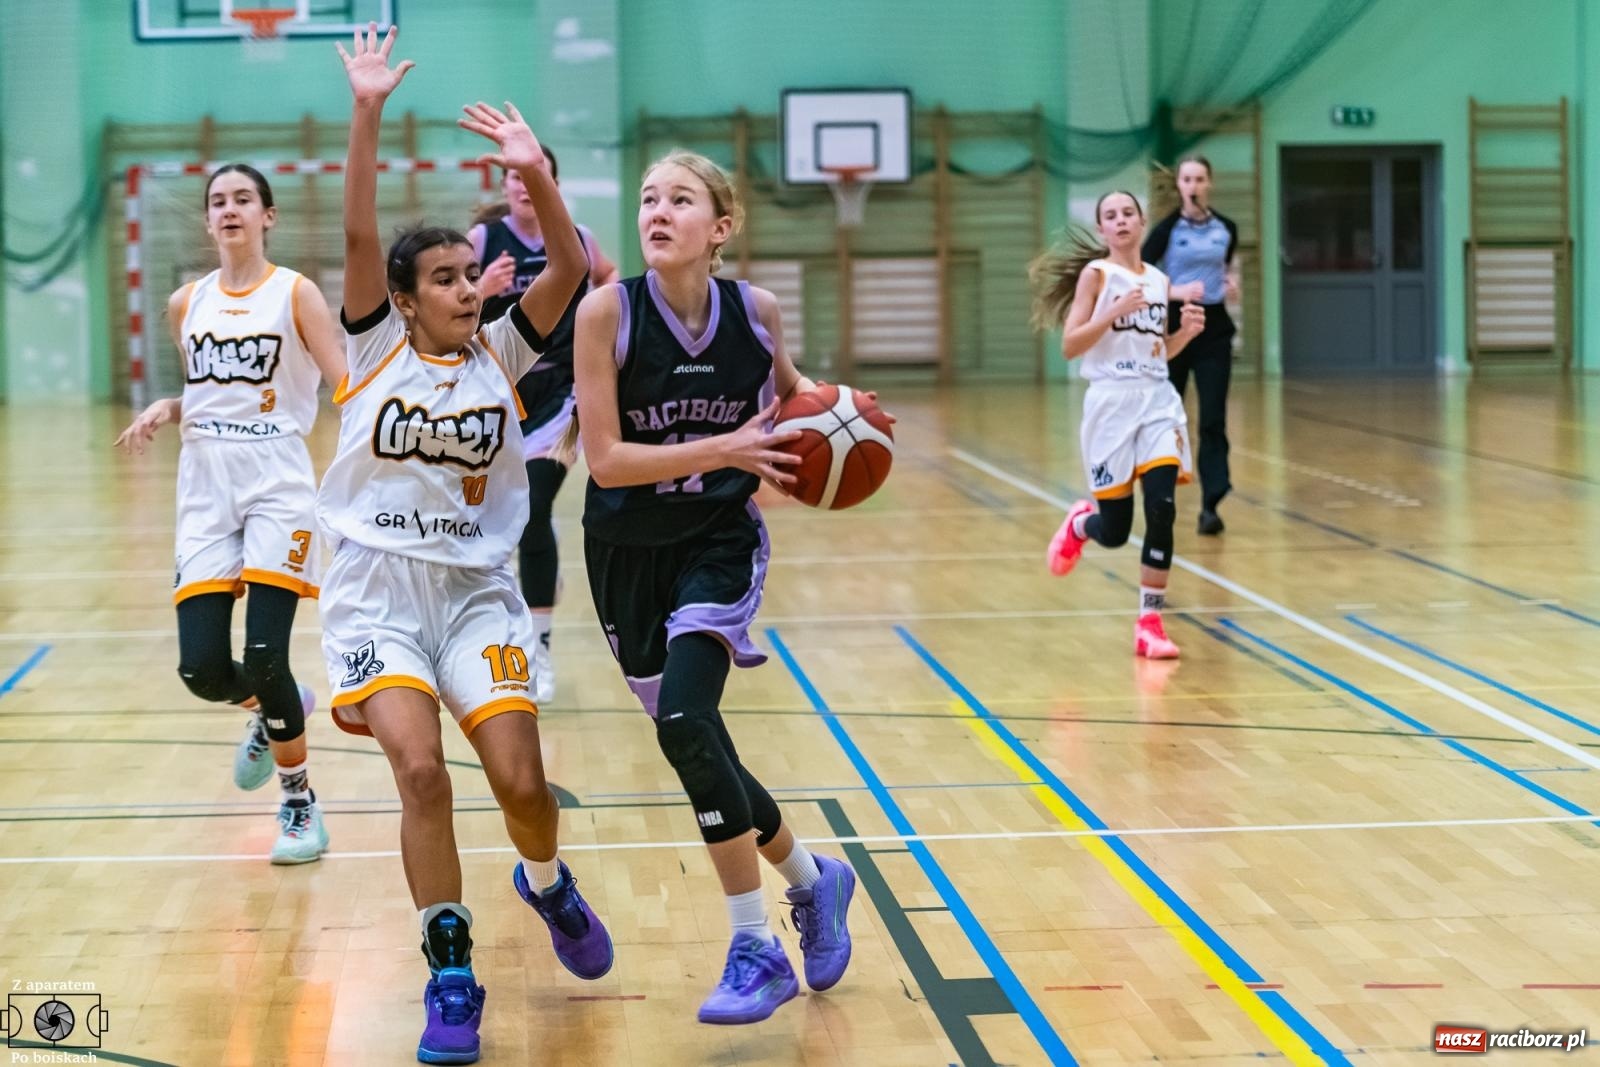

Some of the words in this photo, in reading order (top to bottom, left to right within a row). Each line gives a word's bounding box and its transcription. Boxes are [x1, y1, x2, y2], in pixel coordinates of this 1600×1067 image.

[260, 389, 276, 412] 3
[462, 475, 487, 505] 10
[288, 530, 312, 564] 3
[481, 643, 530, 683] 10
[703, 810, 724, 826] NBA
